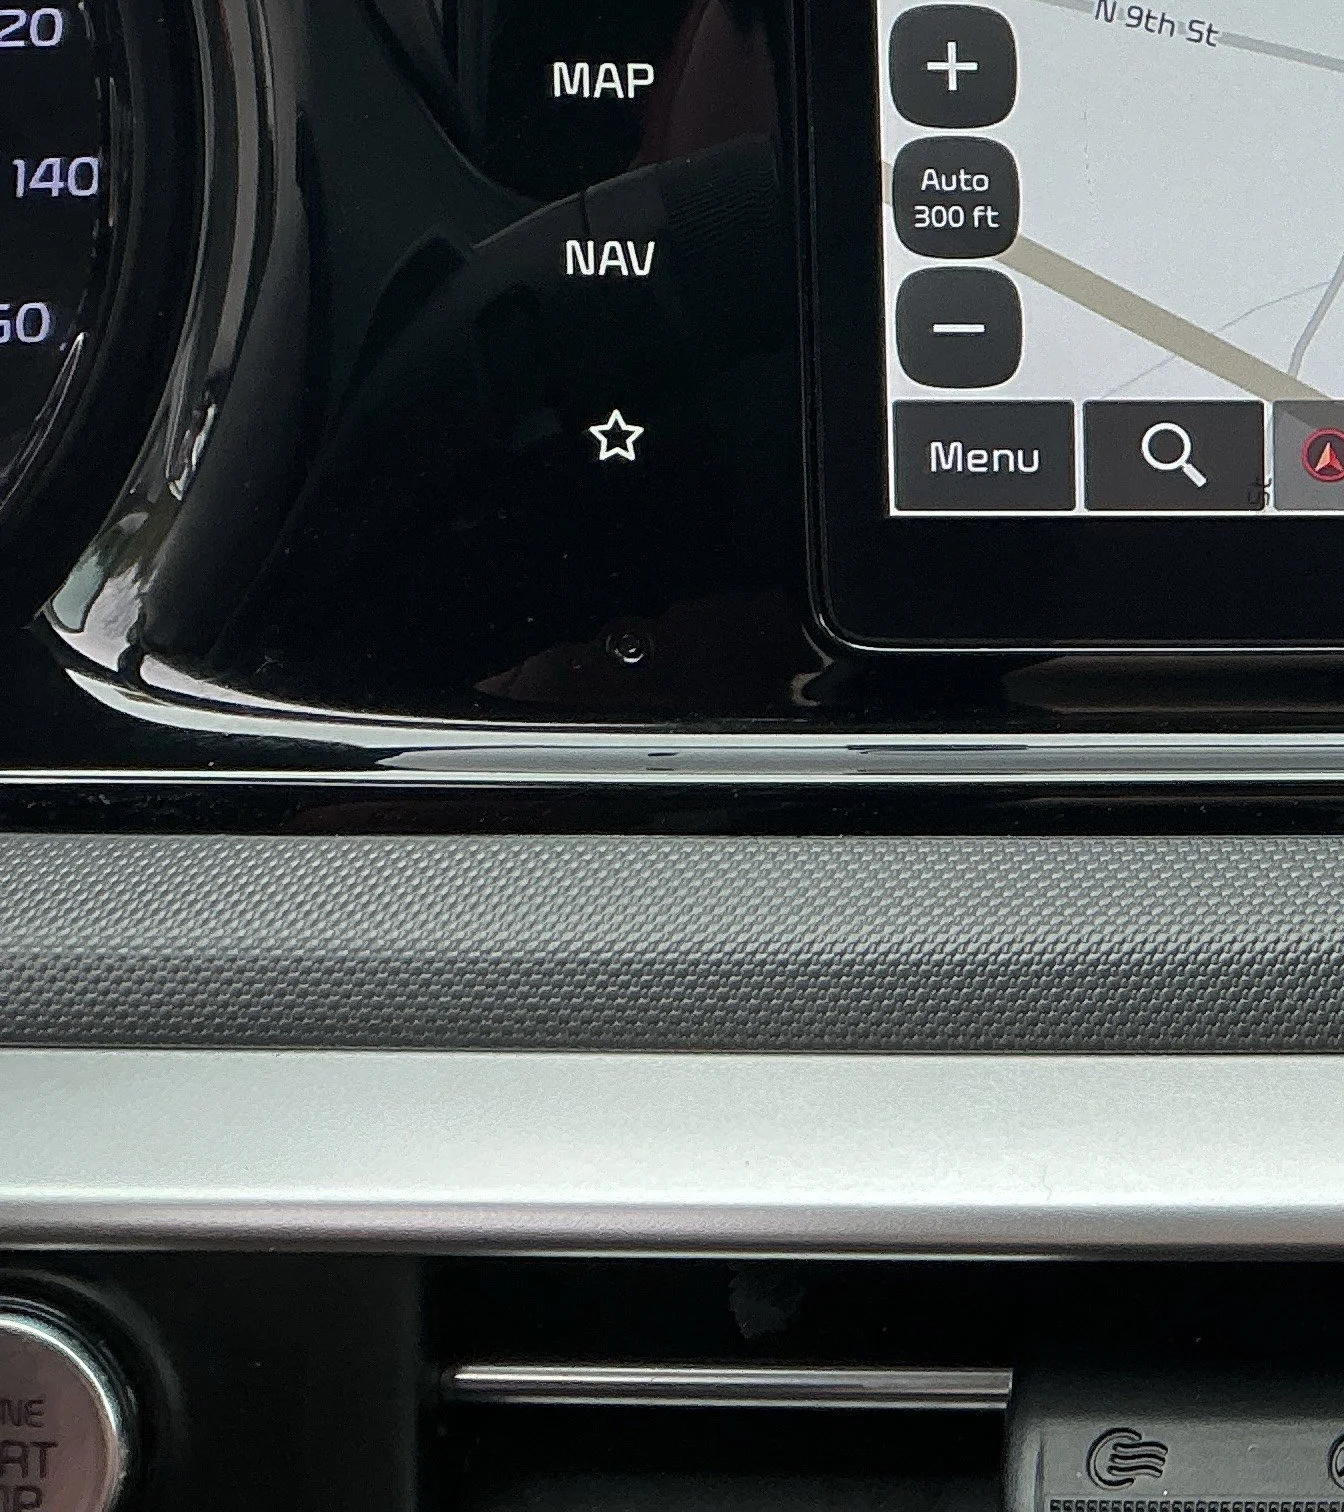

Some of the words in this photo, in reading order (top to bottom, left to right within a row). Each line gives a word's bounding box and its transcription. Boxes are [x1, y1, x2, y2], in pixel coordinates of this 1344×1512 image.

[1125, 5, 1176, 38] 9th
[1186, 19, 1220, 48] St
[552, 61, 656, 99] MAP
[12, 156, 99, 199] 140
[921, 169, 990, 192] Auto
[914, 205, 966, 228] 300
[972, 205, 1000, 228] ft
[565, 239, 657, 277] NAV
[929, 441, 1040, 473] Menu
